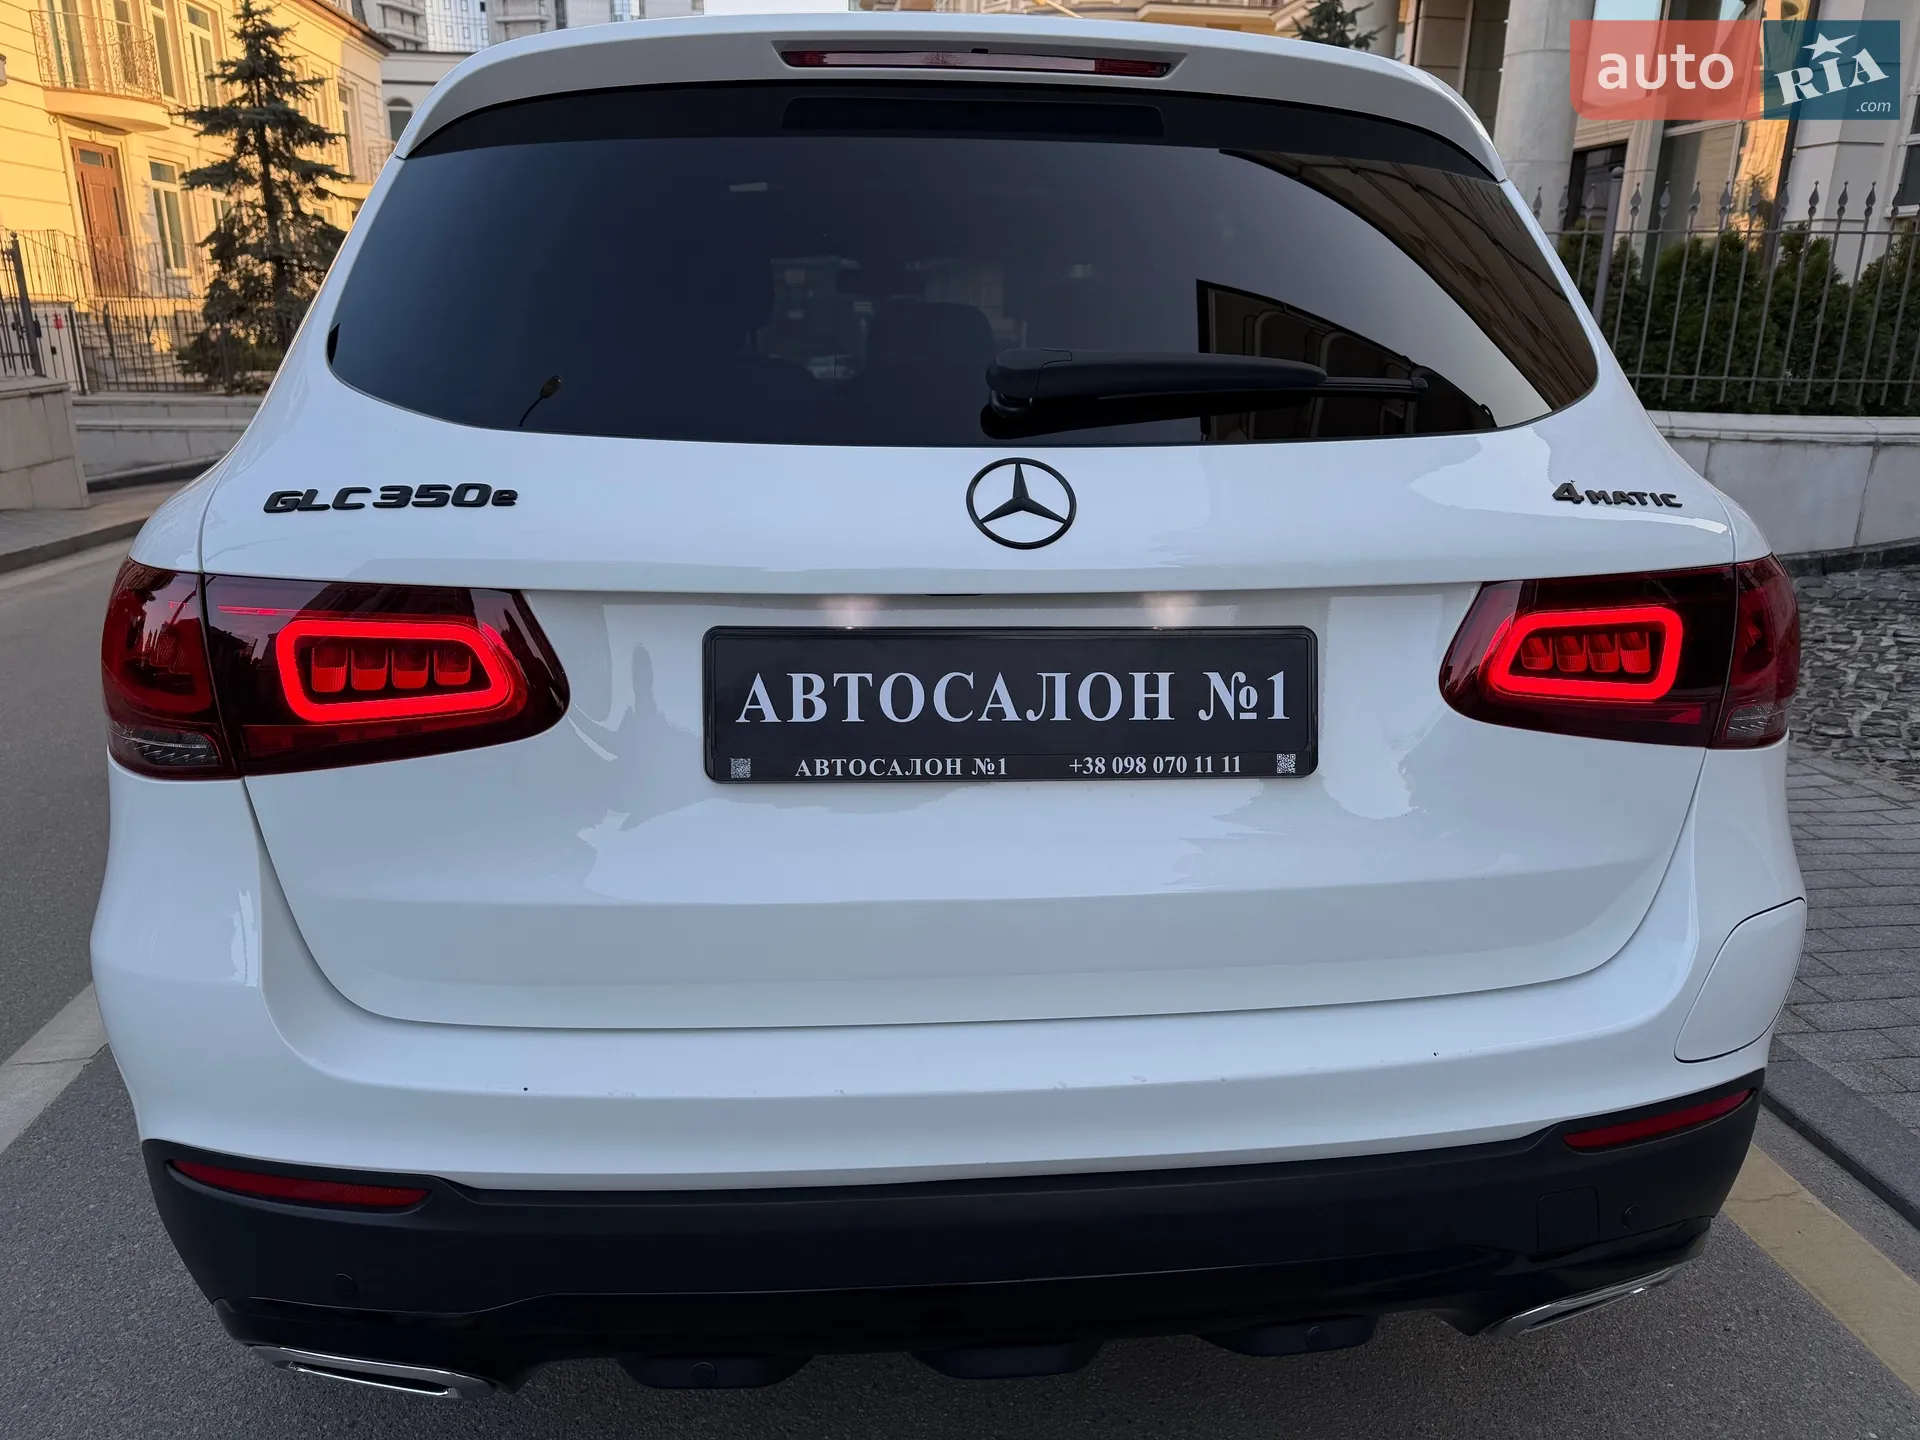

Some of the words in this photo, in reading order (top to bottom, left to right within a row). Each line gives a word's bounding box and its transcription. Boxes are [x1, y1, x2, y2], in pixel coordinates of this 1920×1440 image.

[1552, 482, 1683, 508] 4MATIC
[735, 672, 1174, 722] АВТОСАЛОН
[1198, 671, 1290, 720] №1
[795, 758, 963, 777] АВТОСАЛОН
[971, 757, 1008, 776] №1
[1069, 756, 1106, 775] +38
[1112, 756, 1147, 774] 098
[1152, 755, 1187, 774] 070
[1194, 755, 1214, 773] 11
[1222, 755, 1241, 773] 11
